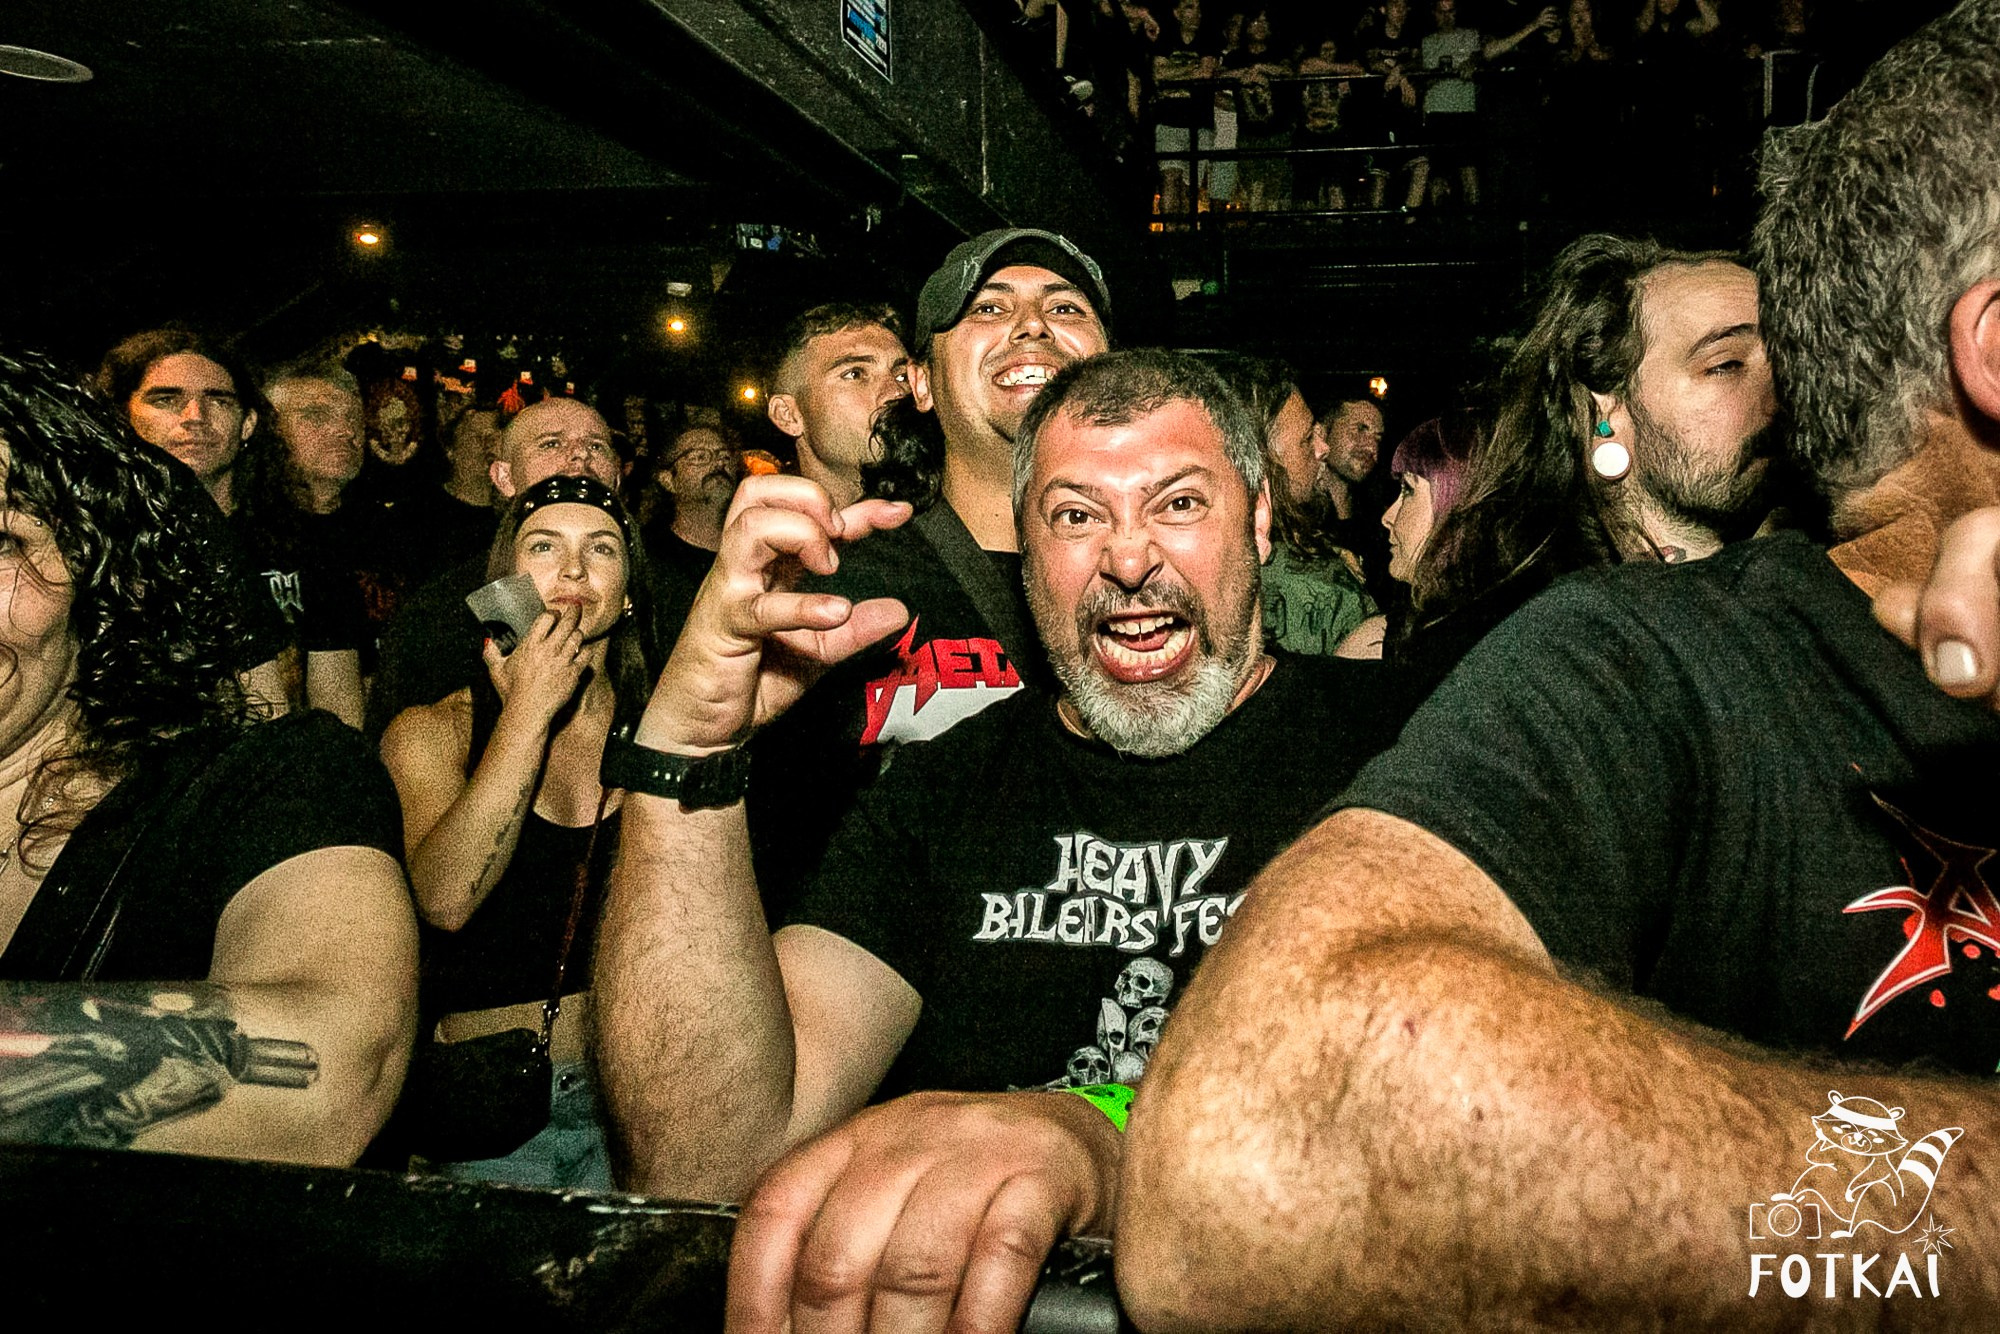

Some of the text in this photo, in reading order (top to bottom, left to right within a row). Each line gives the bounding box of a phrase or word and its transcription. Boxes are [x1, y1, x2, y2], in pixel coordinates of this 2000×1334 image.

[859, 613, 1021, 746] MET
[1046, 832, 1229, 923] HEAVY
[1168, 891, 1249, 956] FE
